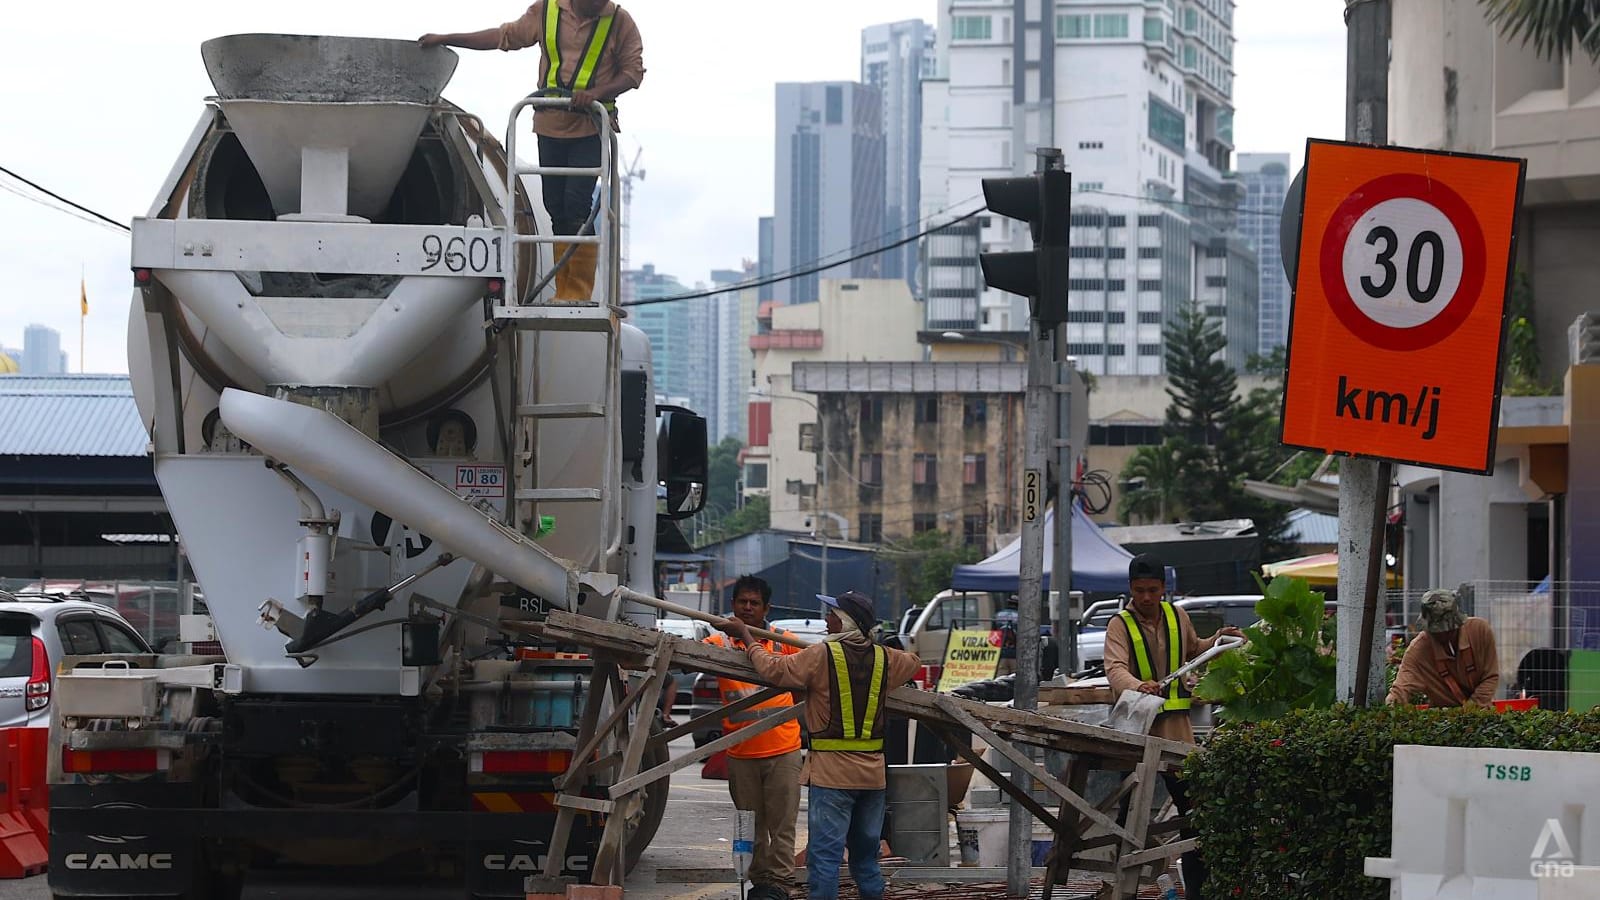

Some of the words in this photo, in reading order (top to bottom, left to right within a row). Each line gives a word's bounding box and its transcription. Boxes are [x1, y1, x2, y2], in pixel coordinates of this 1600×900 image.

[421, 234, 502, 272] 9601
[1360, 225, 1445, 303] 30
[1336, 375, 1441, 440] km/j
[459, 469, 474, 484] 70
[480, 474, 498, 484] 80
[1027, 472, 1036, 521] 203
[962, 636, 989, 648] VIRAL
[950, 649, 997, 661] CHOWKIT
[1485, 764, 1532, 781] TSSB
[65, 853, 172, 869] CAMC
